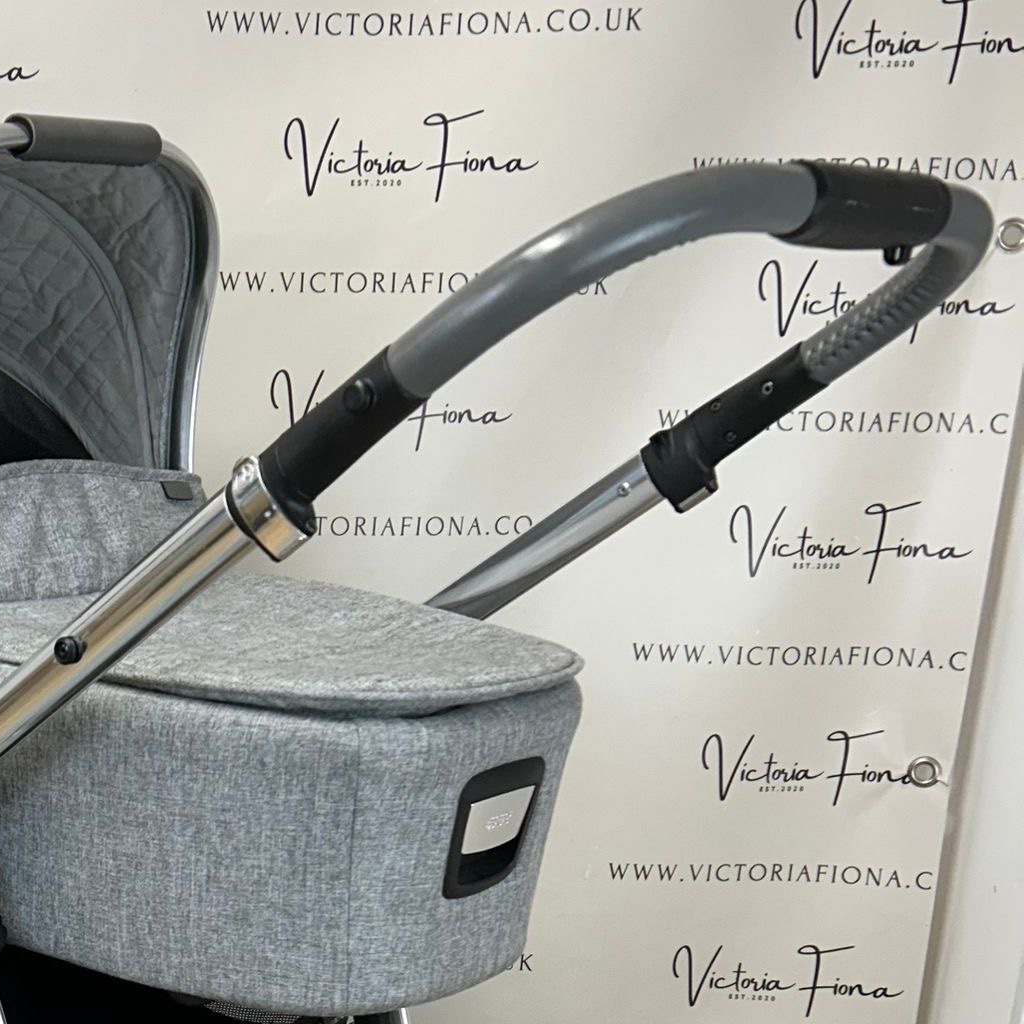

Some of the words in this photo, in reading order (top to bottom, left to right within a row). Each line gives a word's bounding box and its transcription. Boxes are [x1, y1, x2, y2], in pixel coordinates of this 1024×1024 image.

[206, 7, 643, 37] WWW.VICTORIAFIONA.CO.UK
[283, 116, 424, 198] Victoria
[423, 108, 540, 203] Fiona
[728, 504, 865, 579] Victoria
[864, 500, 974, 585] Fiona
[632, 642, 968, 672] WWW.VICTORIAFIONA.C
[701, 733, 825, 802] Victoria
[608, 862, 934, 891] WWW.VICTORIAFIONA.C
[671, 944, 797, 1008] Victoria
[797, 944, 905, 1018] Fiona
